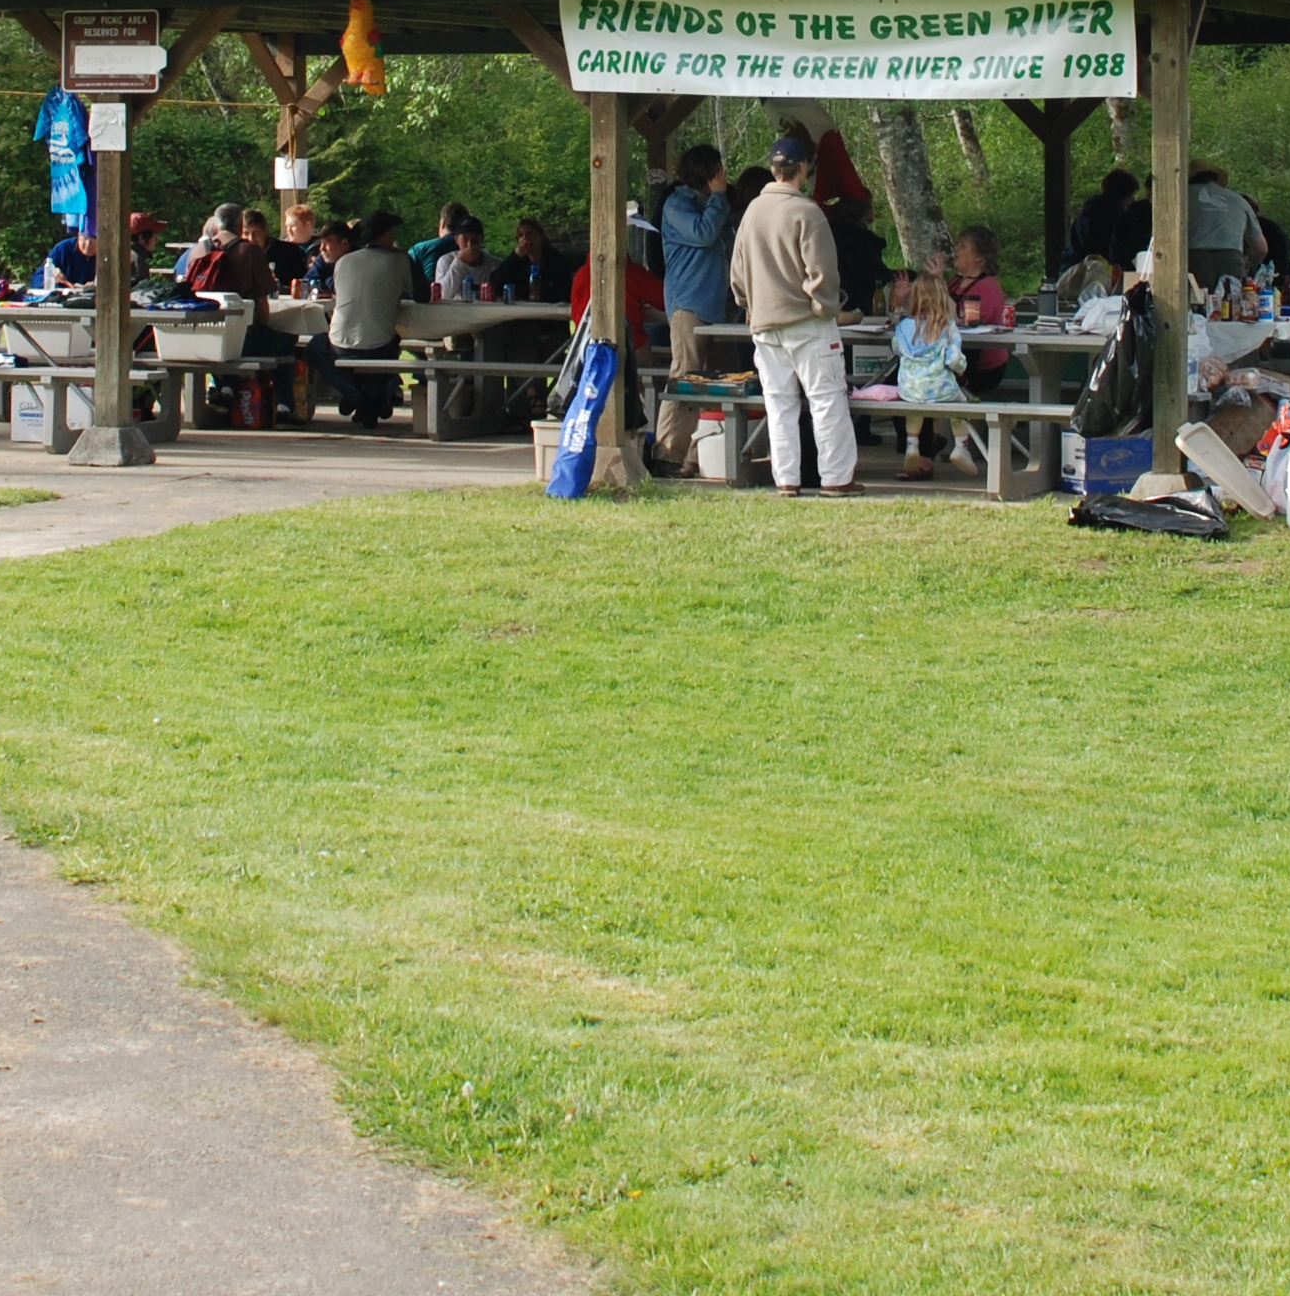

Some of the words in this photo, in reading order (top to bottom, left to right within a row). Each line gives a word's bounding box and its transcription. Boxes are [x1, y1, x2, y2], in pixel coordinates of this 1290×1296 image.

[73, 16, 96, 25] GROUP
[100, 16, 123, 25] PICNIC
[127, 15, 148, 24] AREA
[735, 10, 776, 38] OF
[788, 13, 856, 40] THE
[869, 11, 992, 41] GREEN
[1006, 0, 1115, 40] RIVER
[84, 27, 119, 37] RESERVED
[123, 27, 137, 37] FOR
[577, 50, 667, 76] CARING
[676, 53, 725, 79] FOR
[736, 54, 782, 79] THE
[792, 55, 878, 81] GREEN
[887, 54, 962, 81] RIVER
[968, 54, 1044, 80] SINCE
[1062, 52, 1127, 79] 1988
